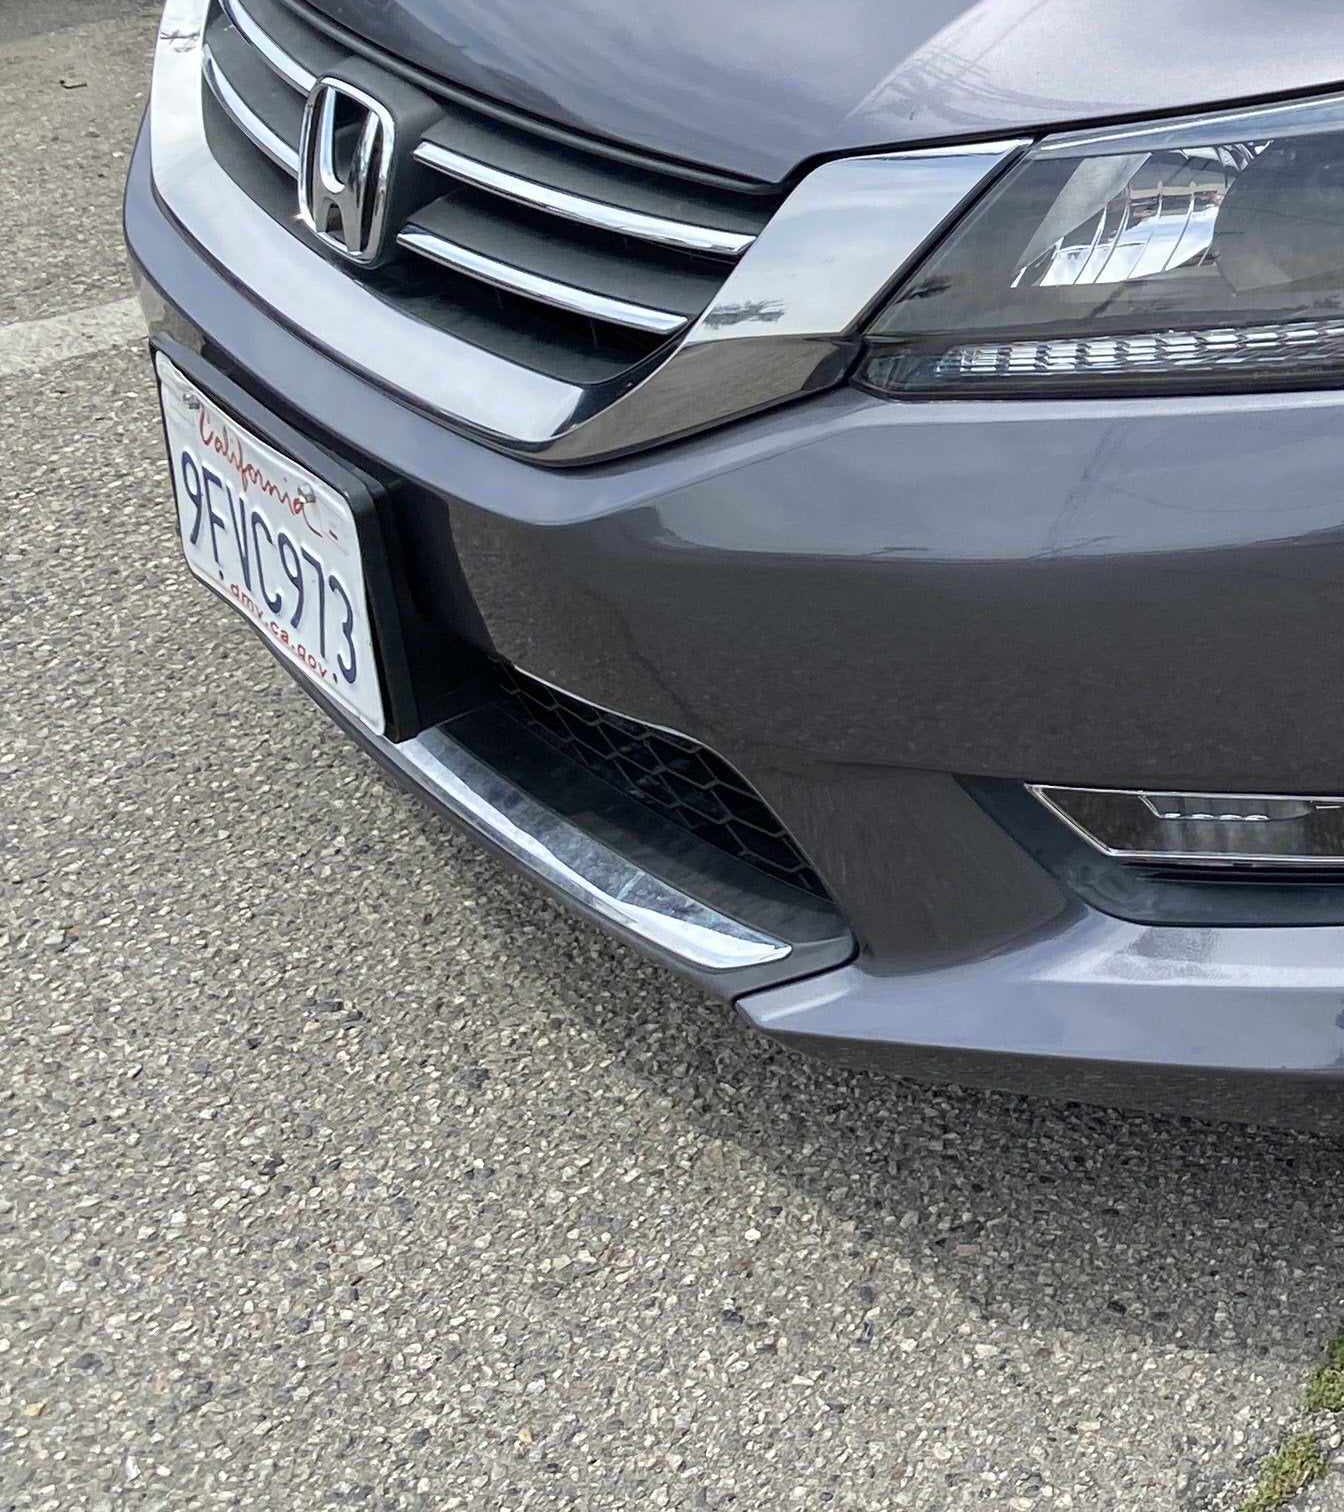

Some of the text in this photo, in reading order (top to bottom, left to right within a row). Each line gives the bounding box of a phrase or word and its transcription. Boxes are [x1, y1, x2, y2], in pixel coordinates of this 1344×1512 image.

[197, 402, 323, 539] California
[180, 449, 358, 685] 9FVC973
[229, 583, 328, 679] dmv.ca.gov
